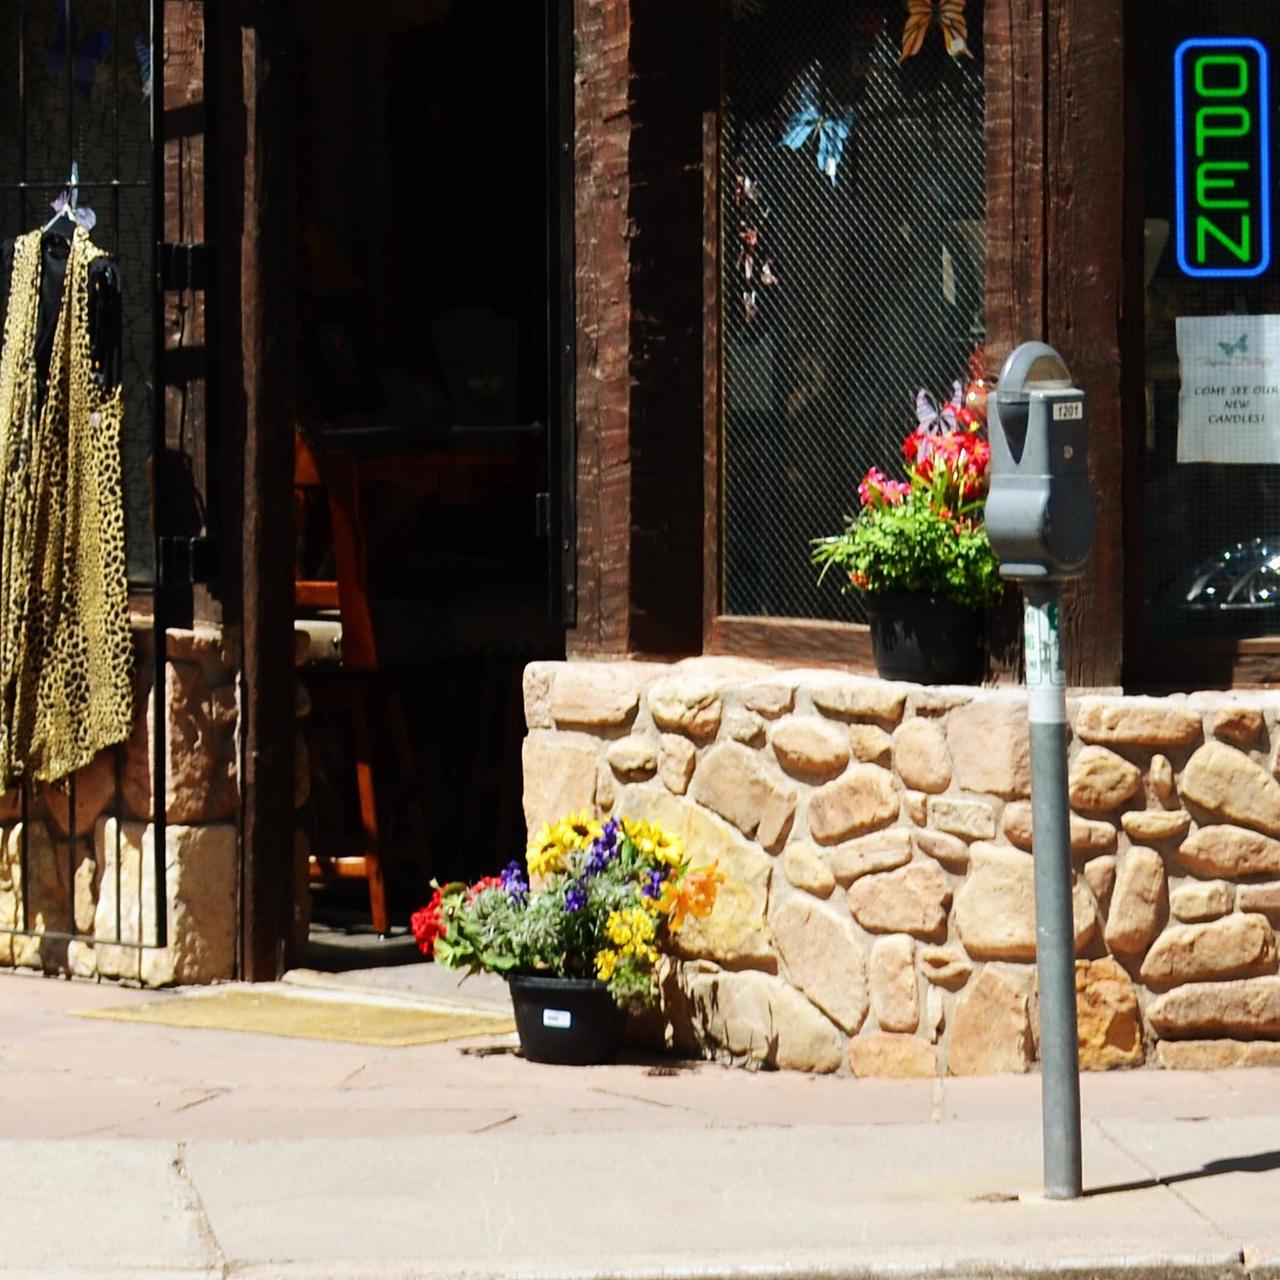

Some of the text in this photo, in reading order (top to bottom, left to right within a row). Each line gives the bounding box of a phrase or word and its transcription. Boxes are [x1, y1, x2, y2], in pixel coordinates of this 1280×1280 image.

[1195, 55, 1250, 263] OPEN
[1194, 385, 1225, 396] COME
[1230, 385, 1250, 396] SEE
[1224, 400, 1250, 410] NEW
[1058, 405, 1079, 418] 1201
